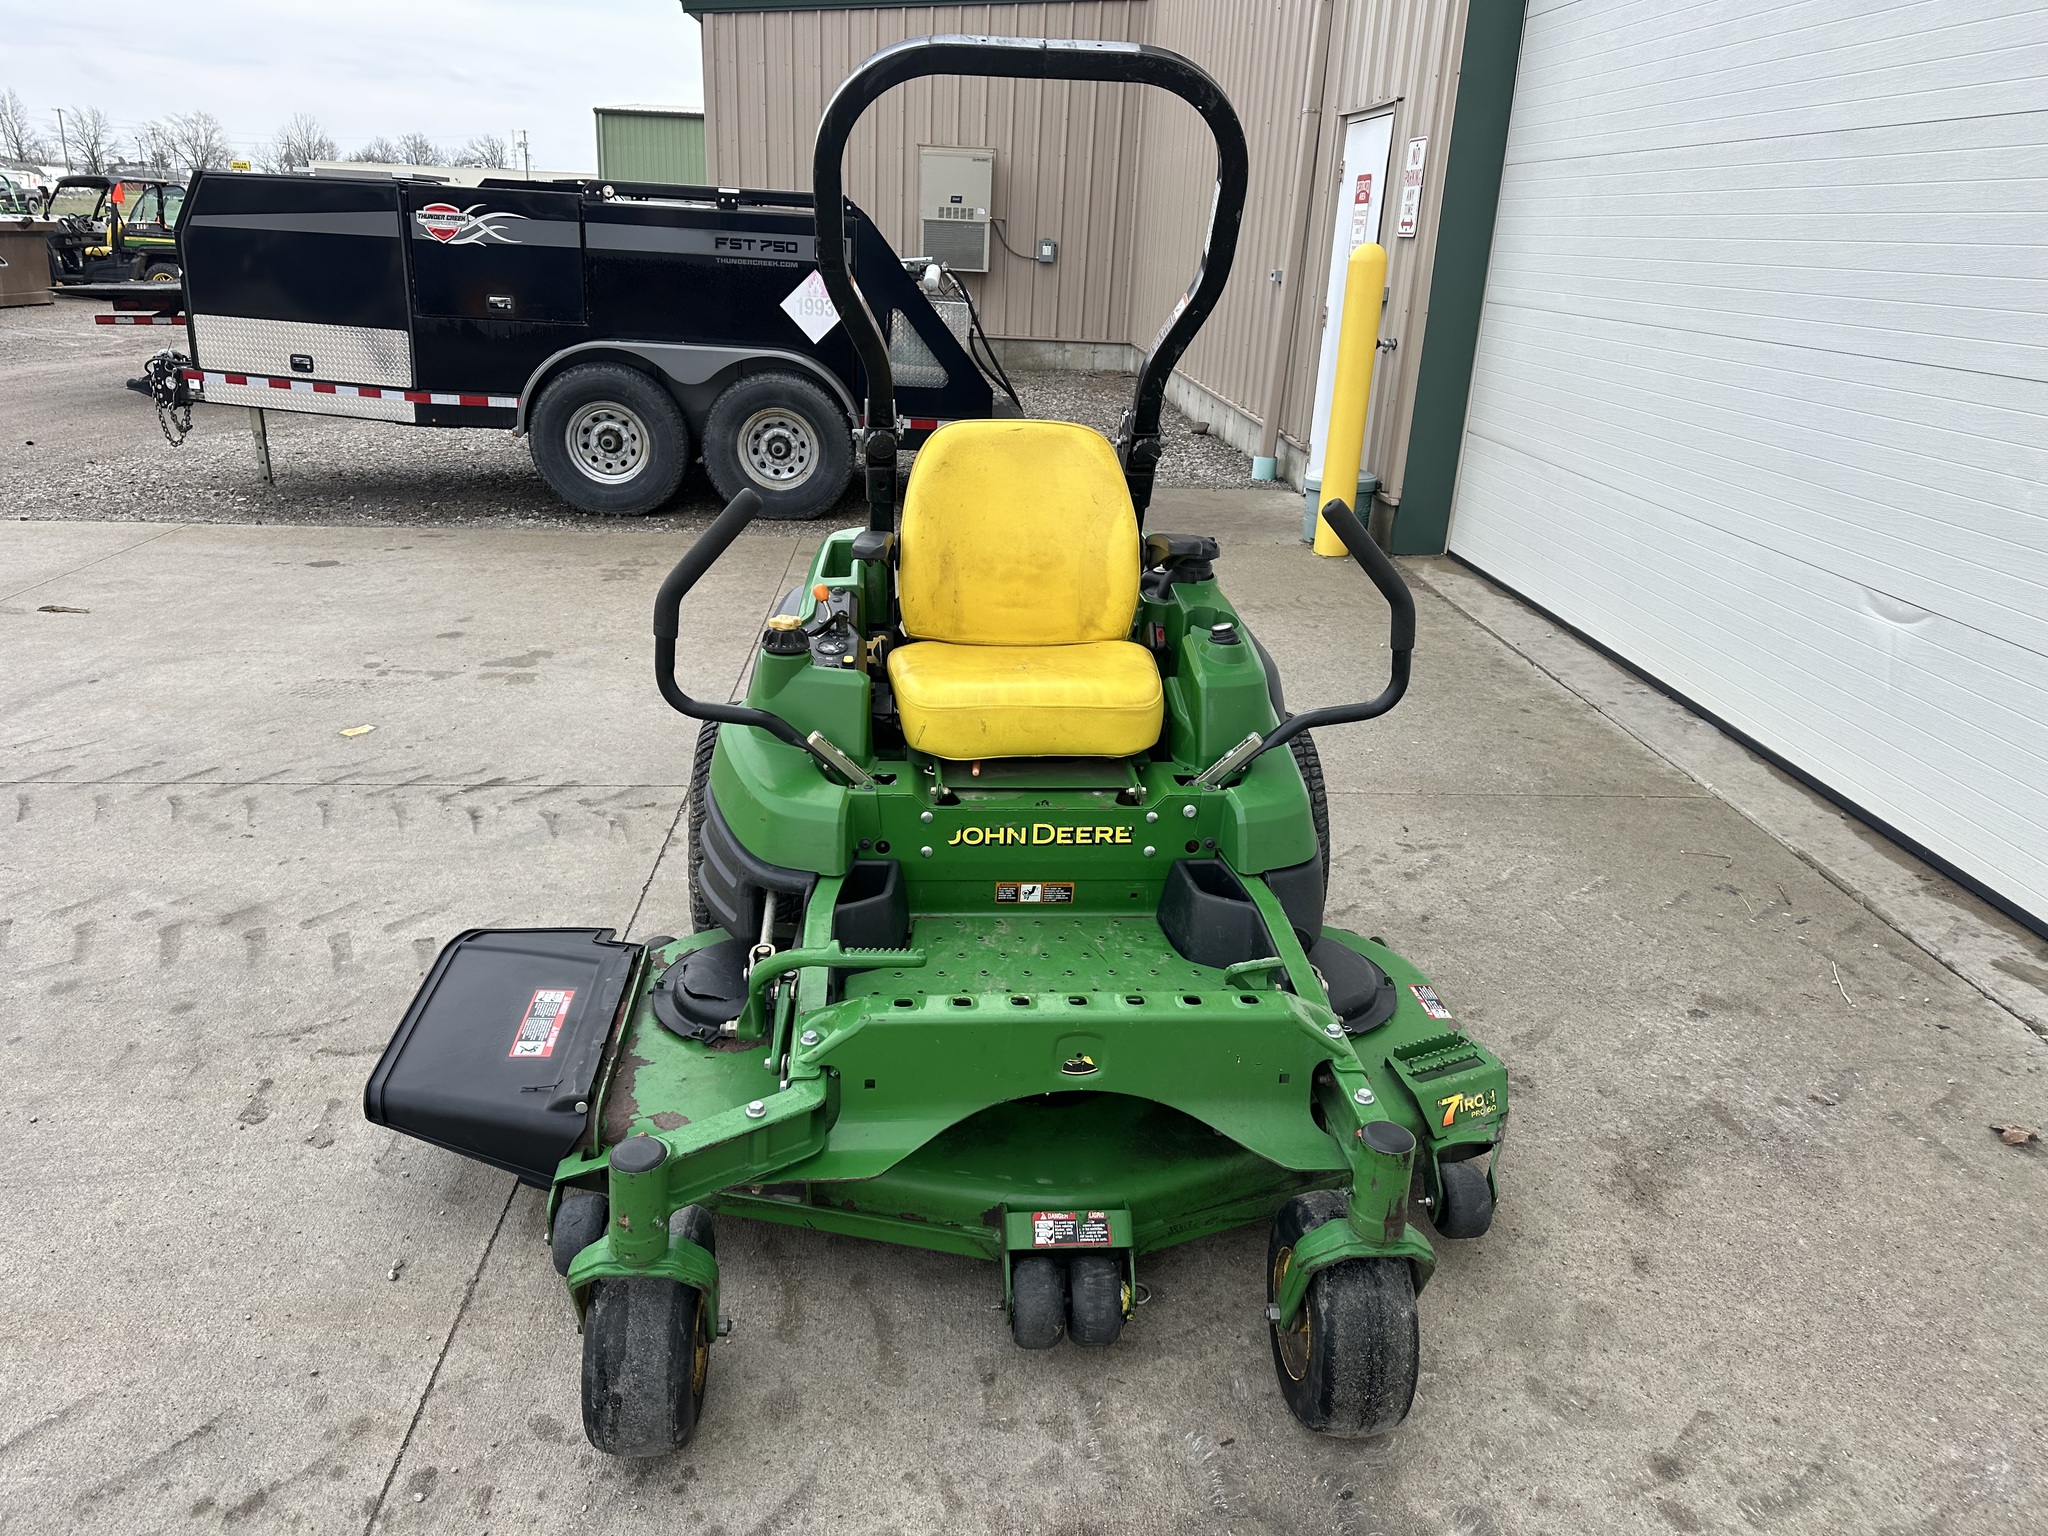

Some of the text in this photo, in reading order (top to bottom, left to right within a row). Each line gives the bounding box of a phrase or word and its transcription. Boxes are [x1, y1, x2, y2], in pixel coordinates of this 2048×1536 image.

[1411, 147, 1420, 165] NO
[715, 237, 798, 253] FST 750
[716, 257, 798, 268] THUNDERCREEK.COM
[797, 297, 835, 317] 1993
[947, 823, 1134, 846] JOHN DEERE
